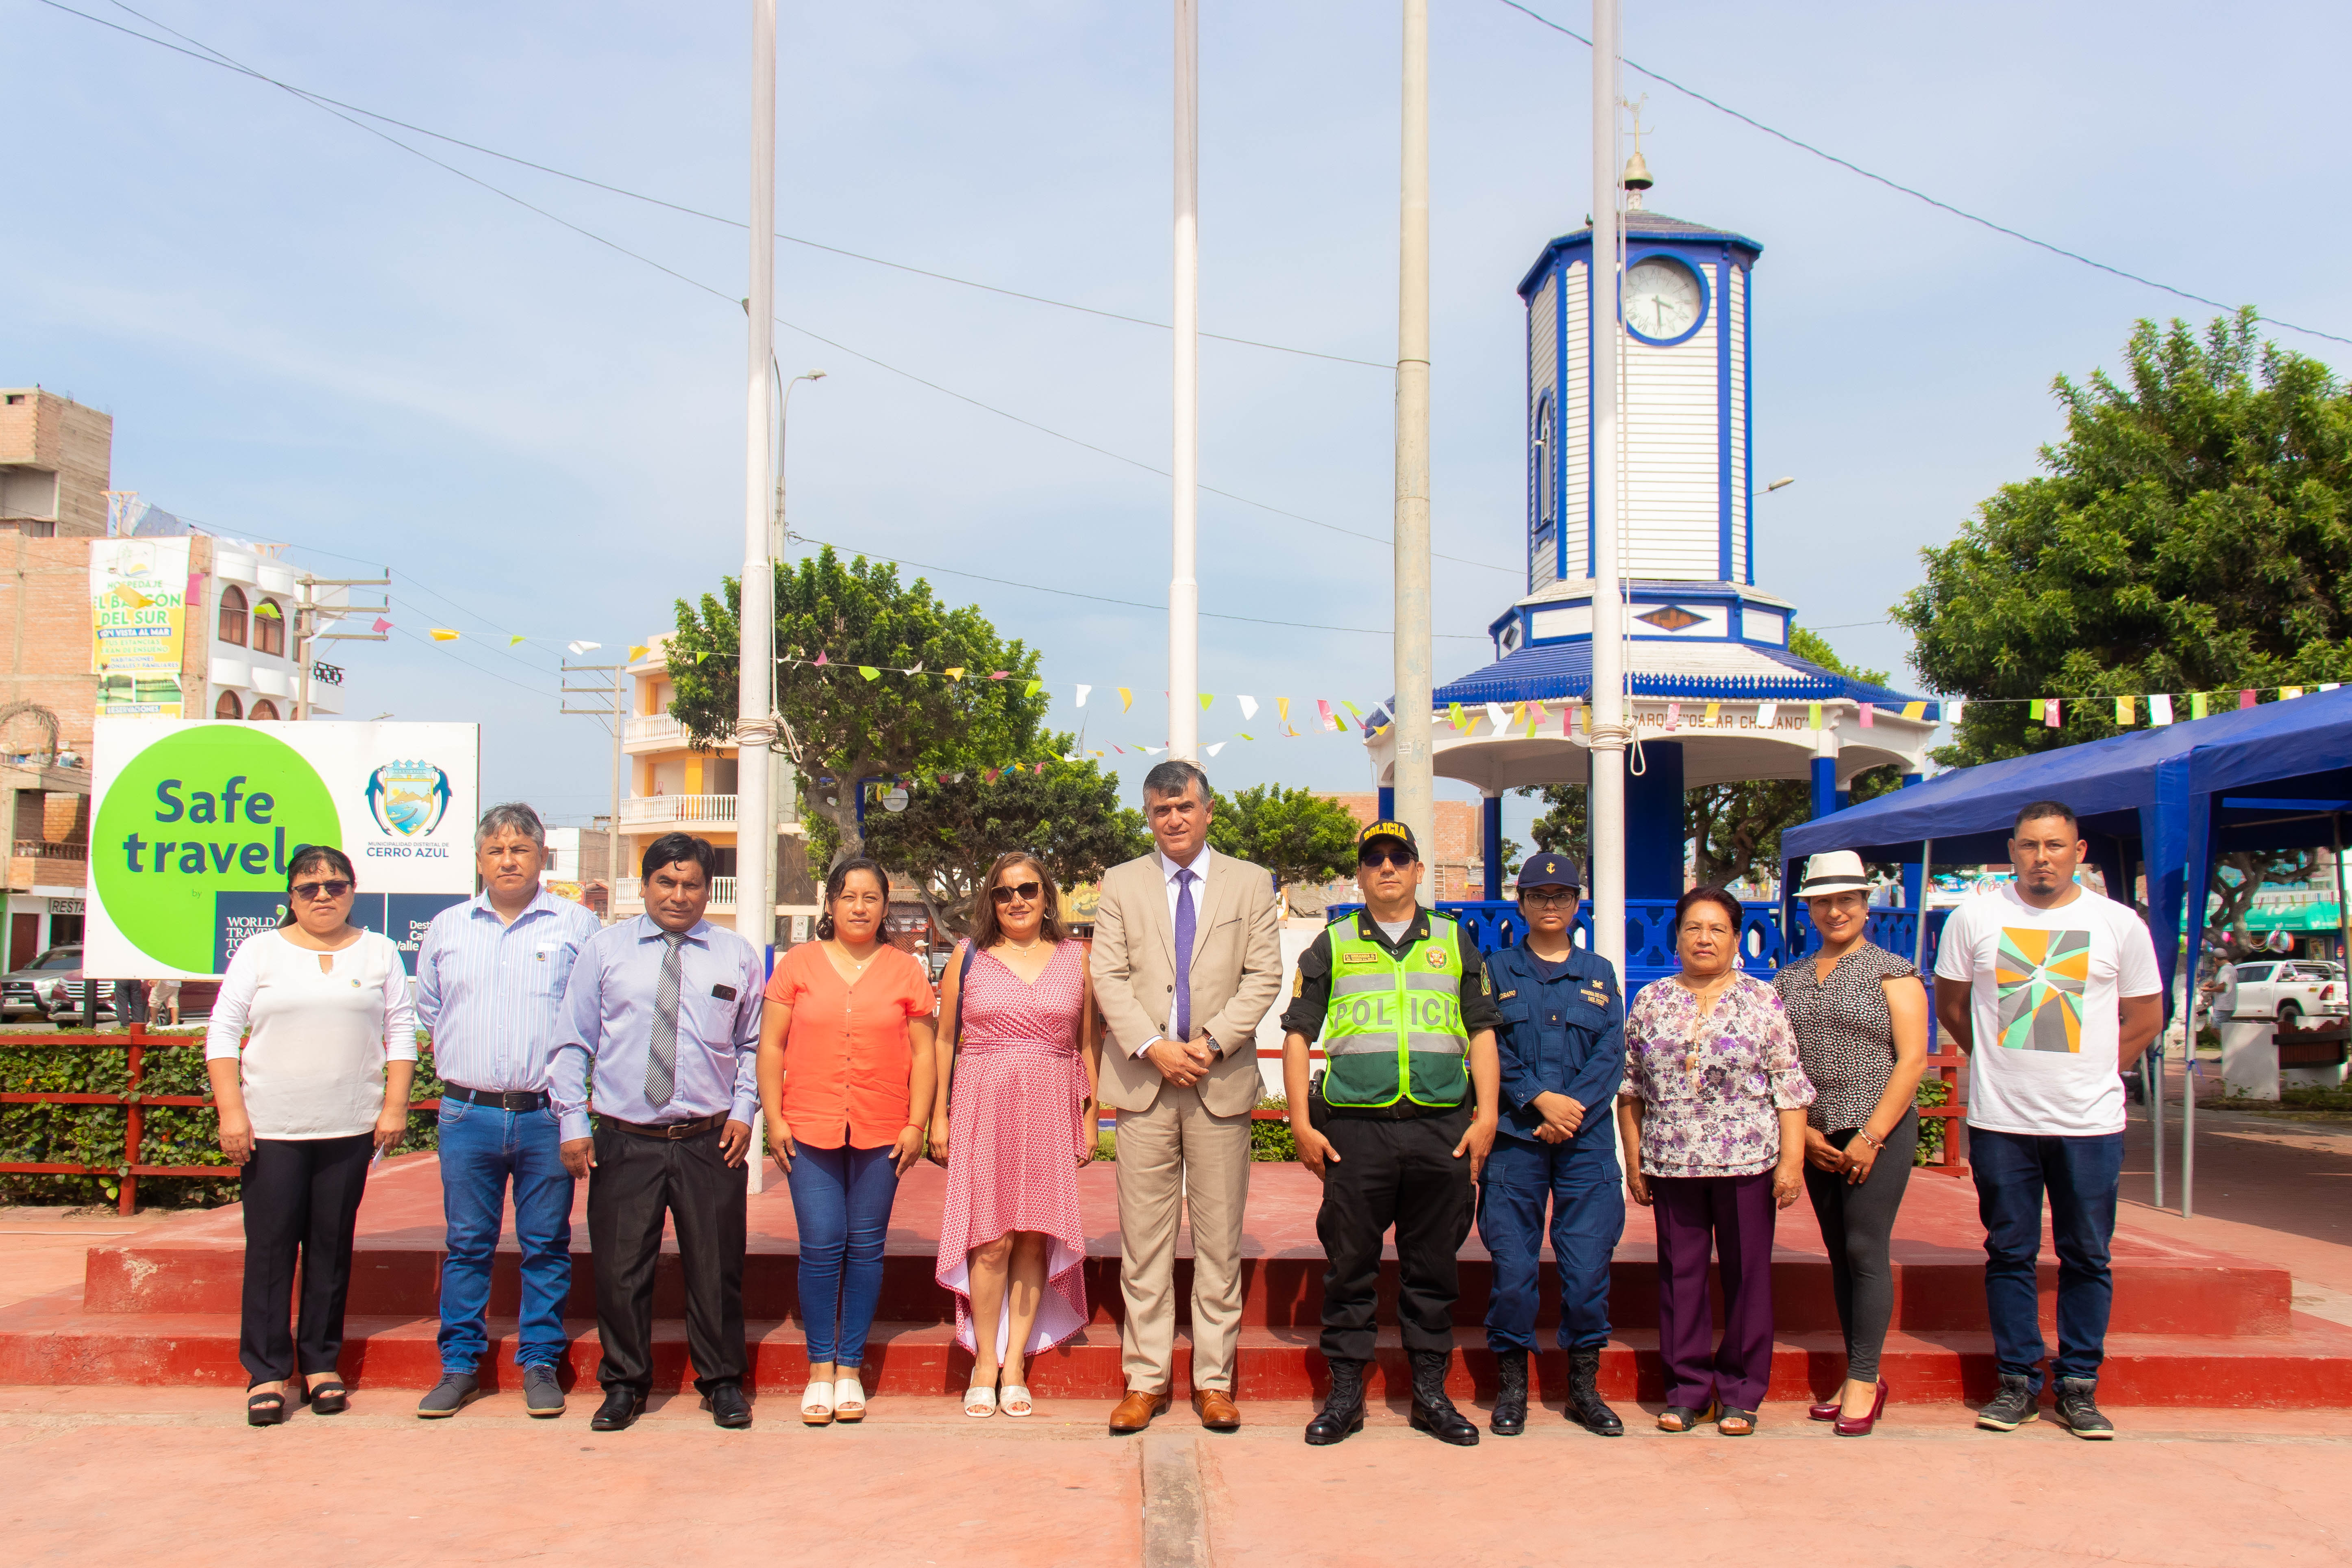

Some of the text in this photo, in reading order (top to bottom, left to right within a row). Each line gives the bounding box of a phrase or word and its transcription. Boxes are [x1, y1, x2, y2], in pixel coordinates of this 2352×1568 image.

[107, 580, 162, 589] HOPEDAJE
[111, 590, 180, 608] BCÓN
[102, 611, 166, 626] DEL SUR
[115, 629, 137, 637] VISTA
[150, 628, 170, 636] MAR
[156, 776, 275, 824] Safe
[1364, 822, 1407, 841] POLICIA
[367, 847, 449, 857] CERRO AZUL
[192, 889, 202, 898] by
[226, 917, 276, 927] WORLD
